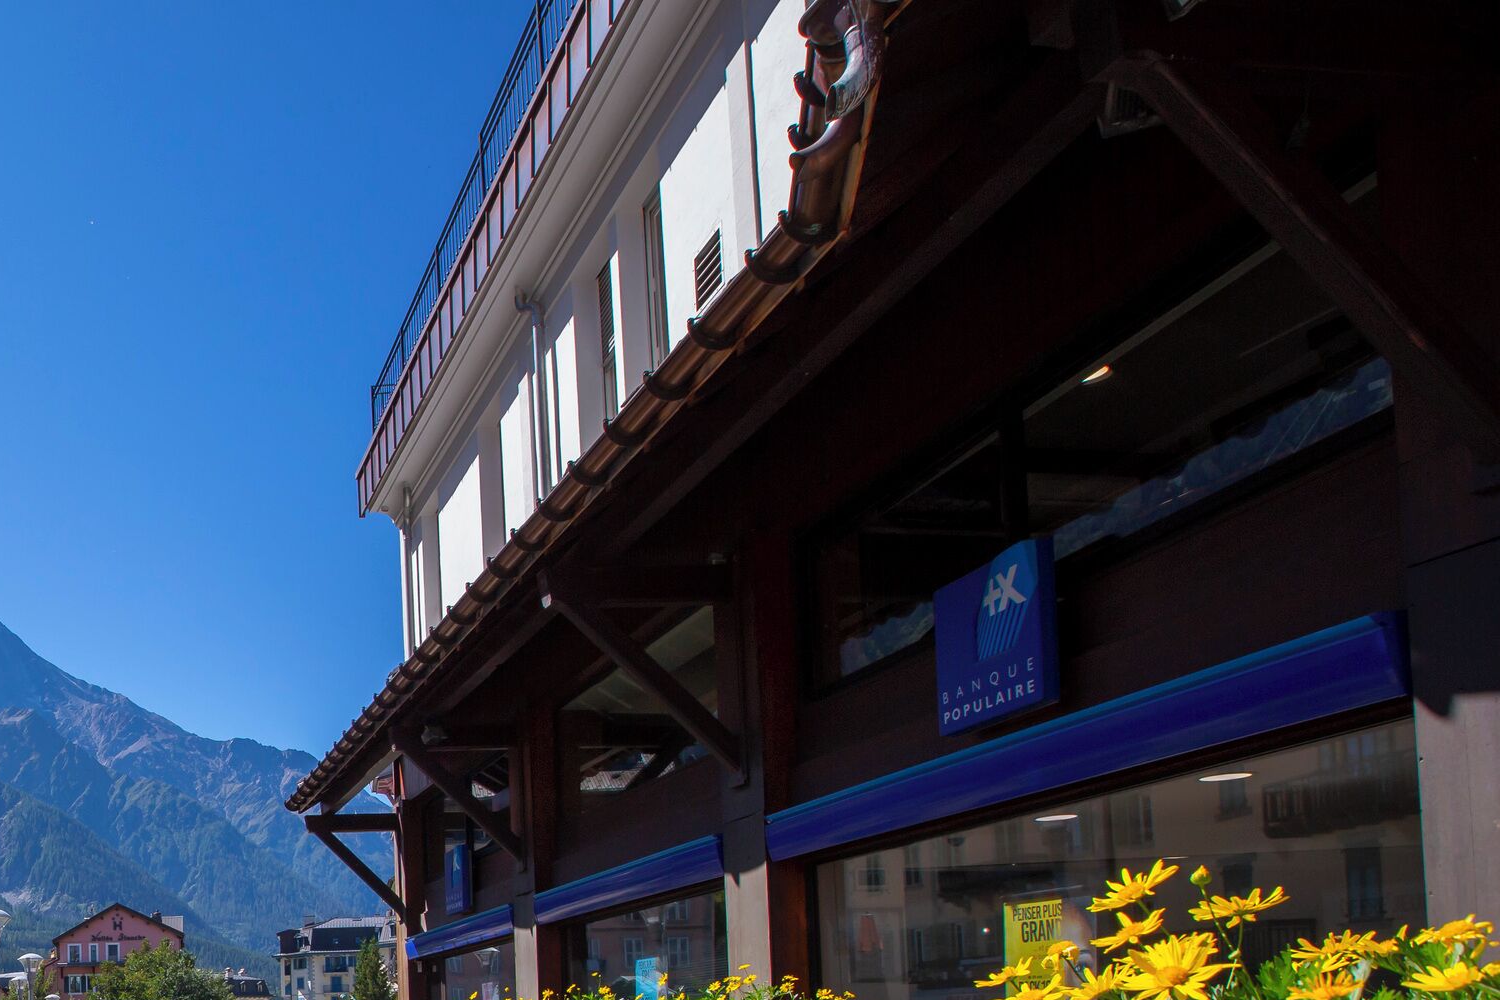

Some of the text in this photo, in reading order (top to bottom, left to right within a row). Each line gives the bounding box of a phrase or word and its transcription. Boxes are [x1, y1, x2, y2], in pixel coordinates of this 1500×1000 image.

[942, 656, 1034, 705] BANQUE
[943, 679, 1035, 725] POPULAIRE
[1013, 903, 1062, 921] PENSER PLUS
